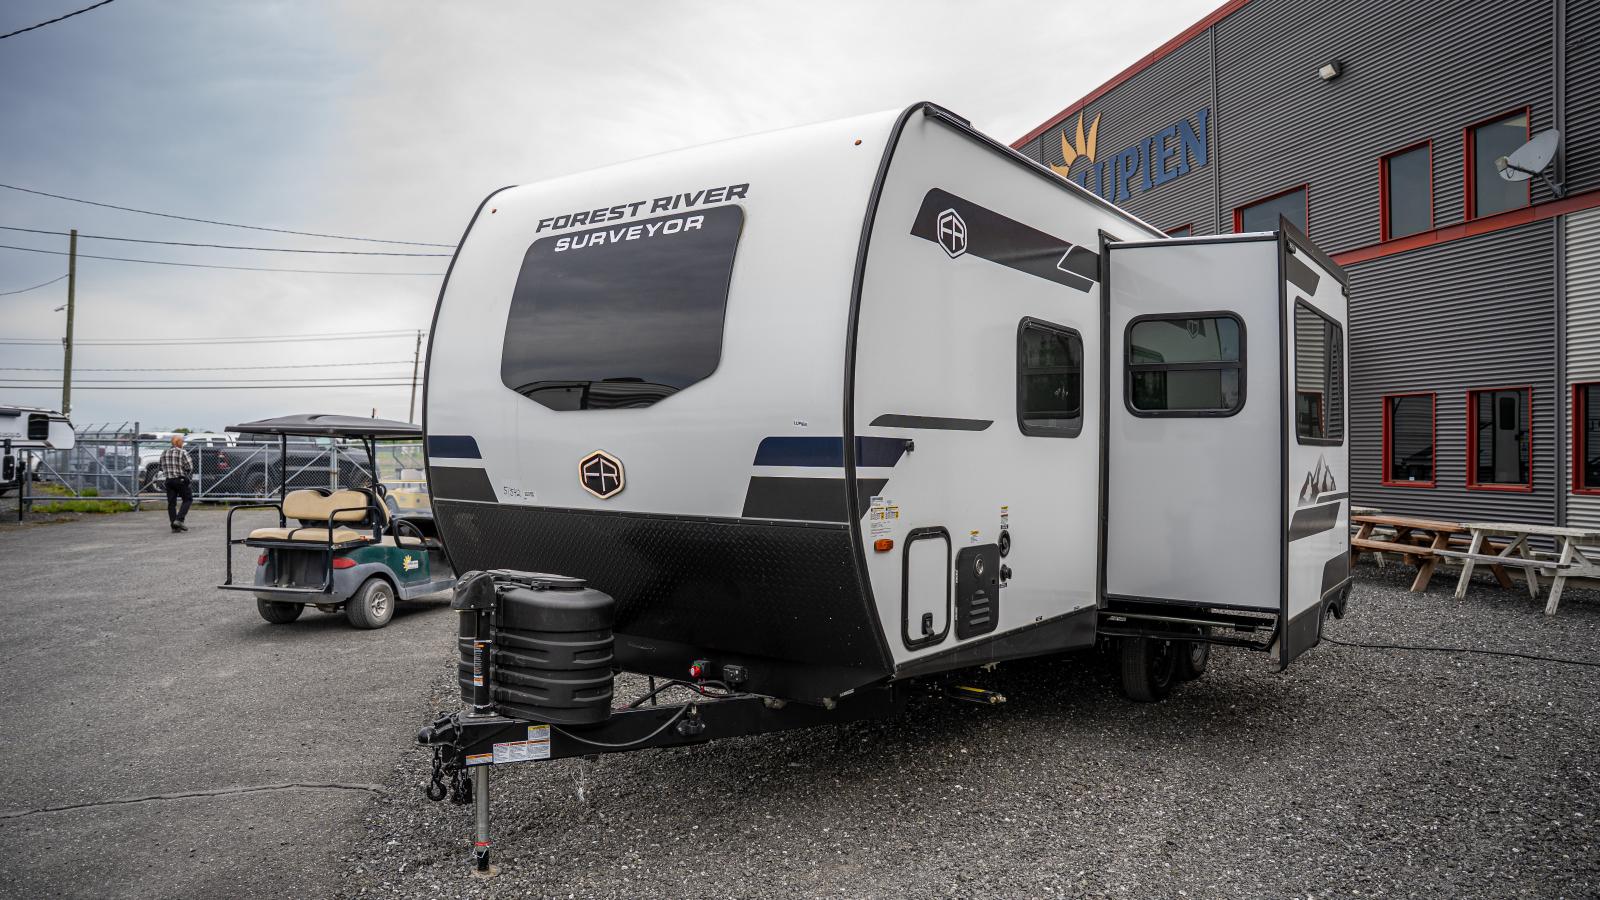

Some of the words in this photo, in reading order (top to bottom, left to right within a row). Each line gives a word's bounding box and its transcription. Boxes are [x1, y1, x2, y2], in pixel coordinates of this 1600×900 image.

[535, 200, 646, 233] FOREST
[649, 183, 750, 214] RIVER
[554, 215, 704, 252] SURVEYOR
